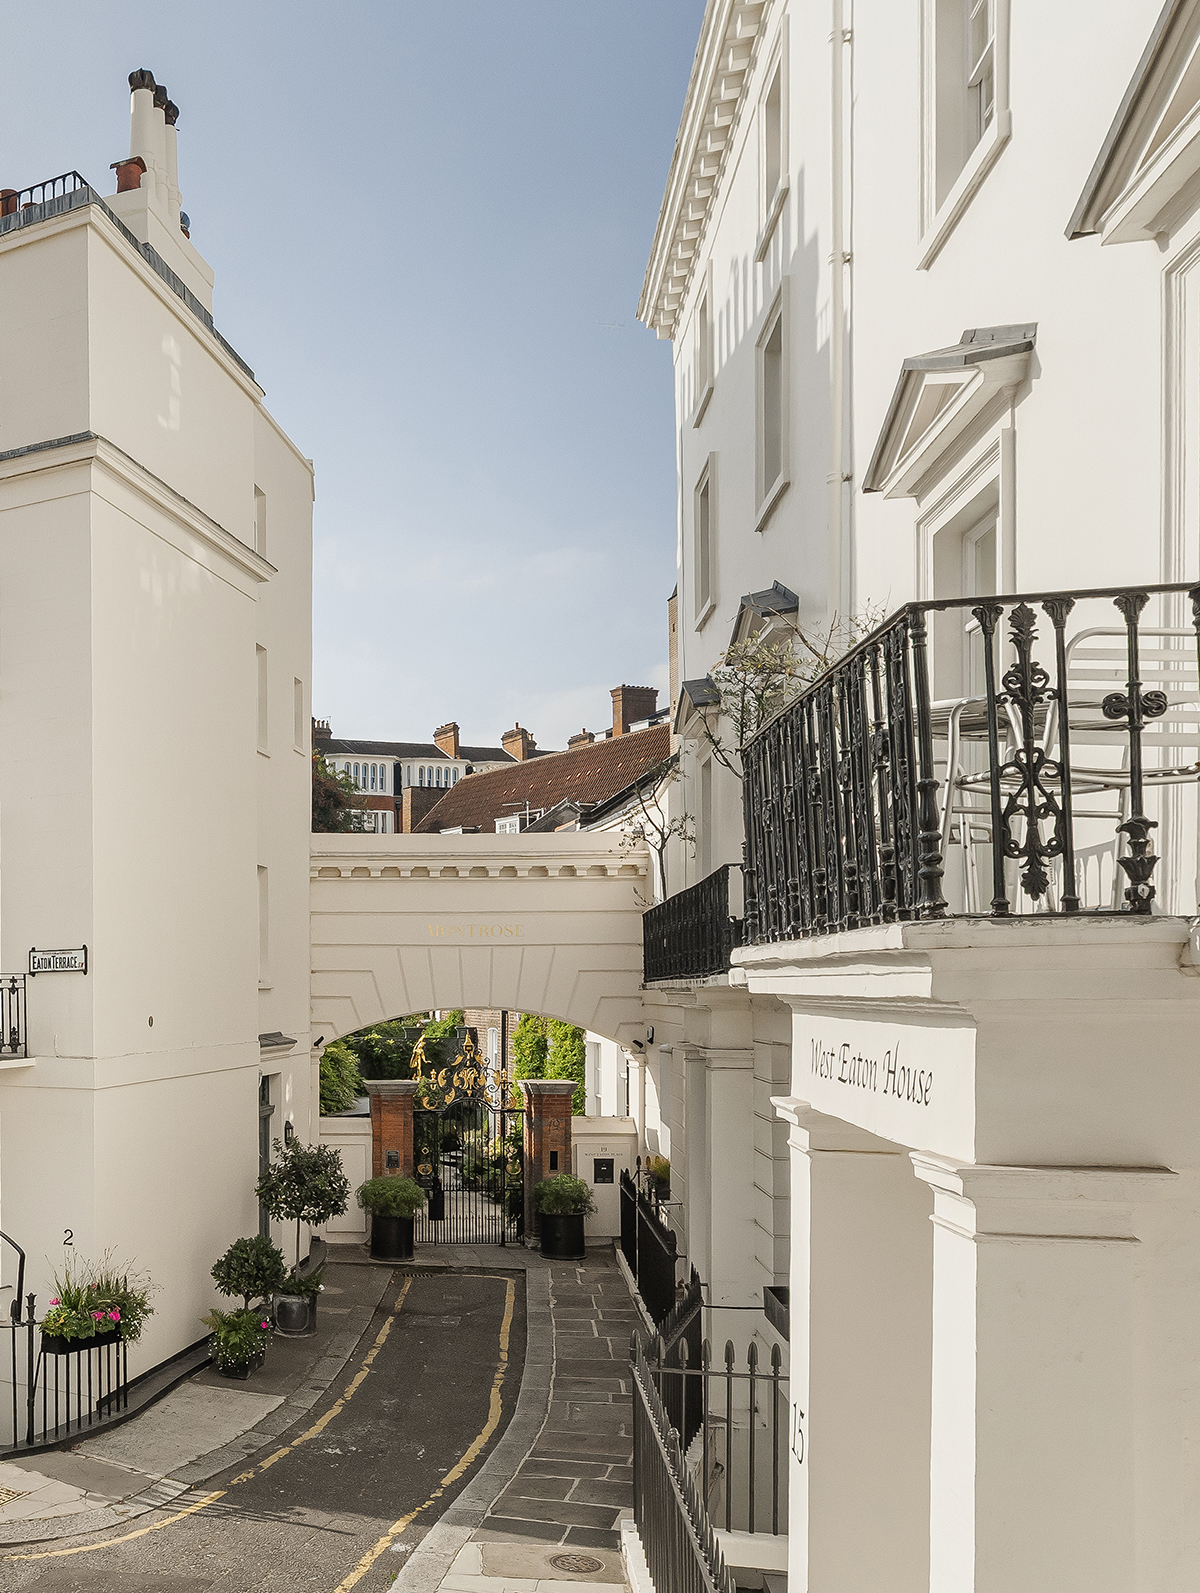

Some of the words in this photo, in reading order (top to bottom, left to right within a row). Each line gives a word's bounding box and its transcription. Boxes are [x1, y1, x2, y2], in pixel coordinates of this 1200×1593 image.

[427, 924, 524, 938] MONTROSE
[32, 955, 51, 970] EATON
[51, 955, 78, 970] TERRACE
[810, 1038, 835, 1080] West
[837, 1042, 878, 1092] Eaton
[882, 1039, 933, 1107] House
[63, 1229, 74, 1246] 2
[791, 1402, 806, 1465] 15
